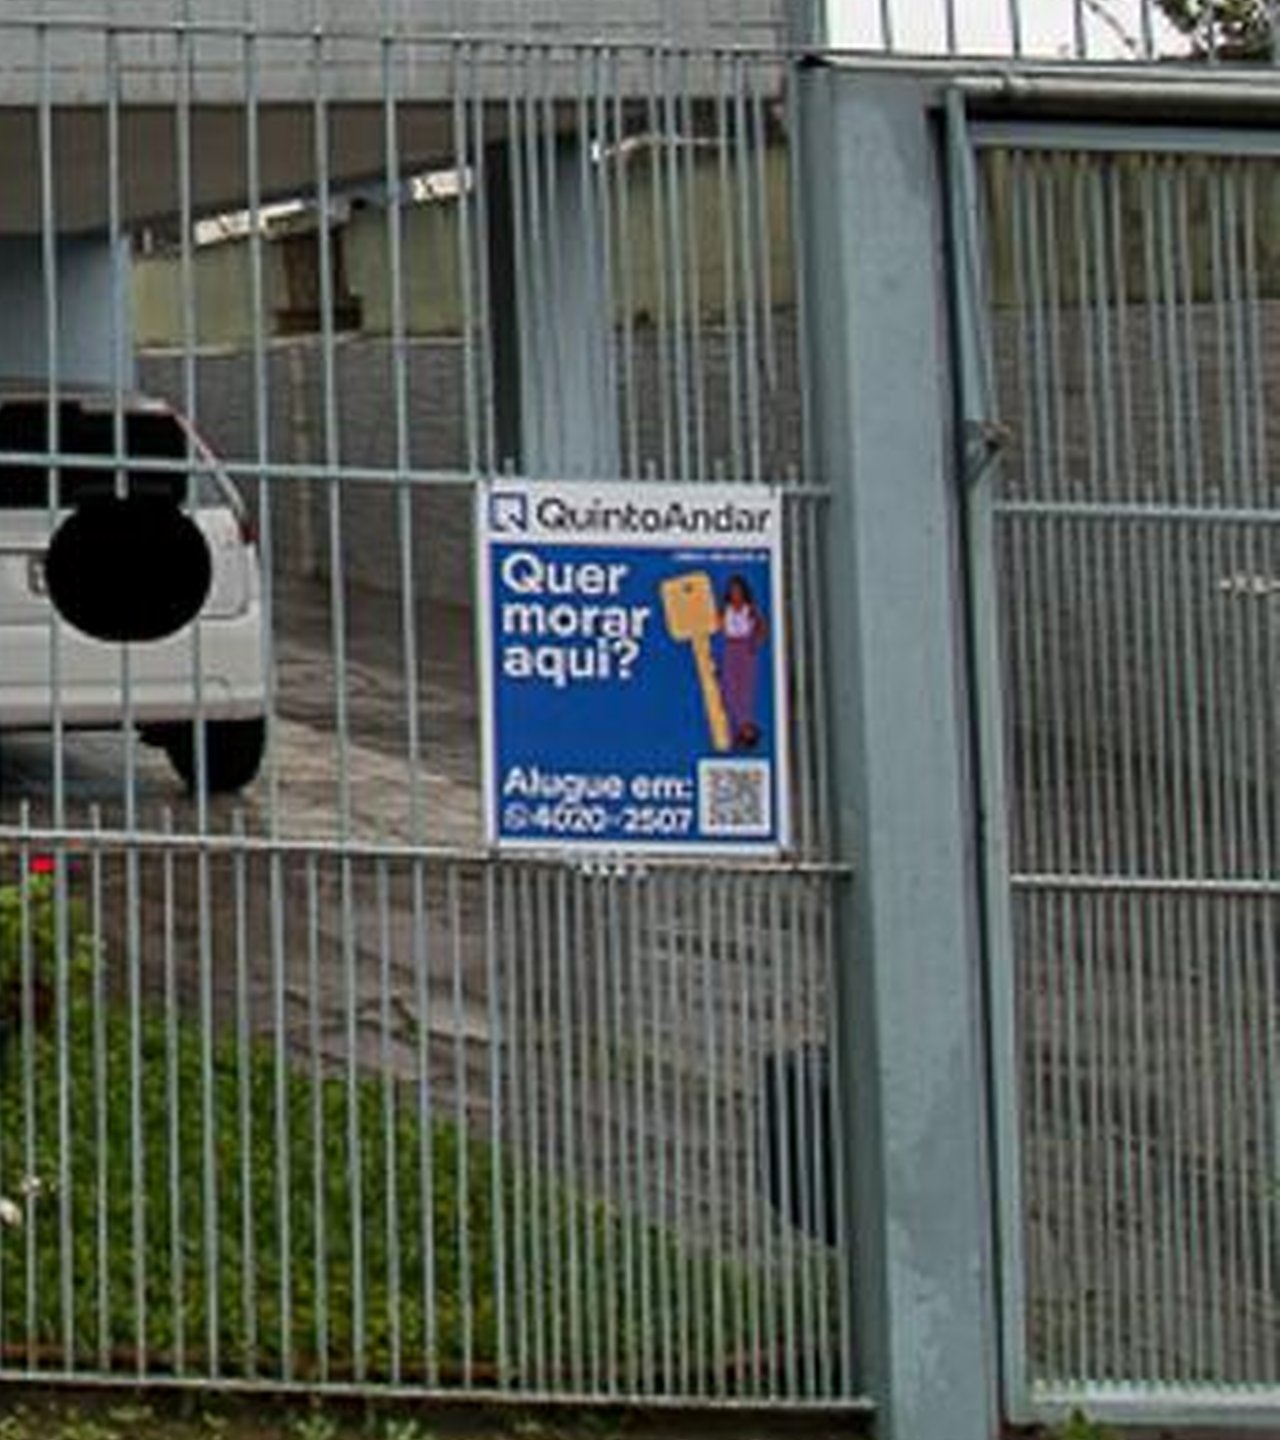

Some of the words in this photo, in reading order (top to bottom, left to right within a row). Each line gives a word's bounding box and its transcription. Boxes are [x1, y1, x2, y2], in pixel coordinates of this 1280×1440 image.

[536, 496, 771, 534] QuintoAndar
[501, 552, 627, 595] Quer
[502, 601, 651, 638] morar
[502, 639, 640, 687] aqui?
[503, 765, 624, 804] Alugue
[630, 775, 694, 801] em:
